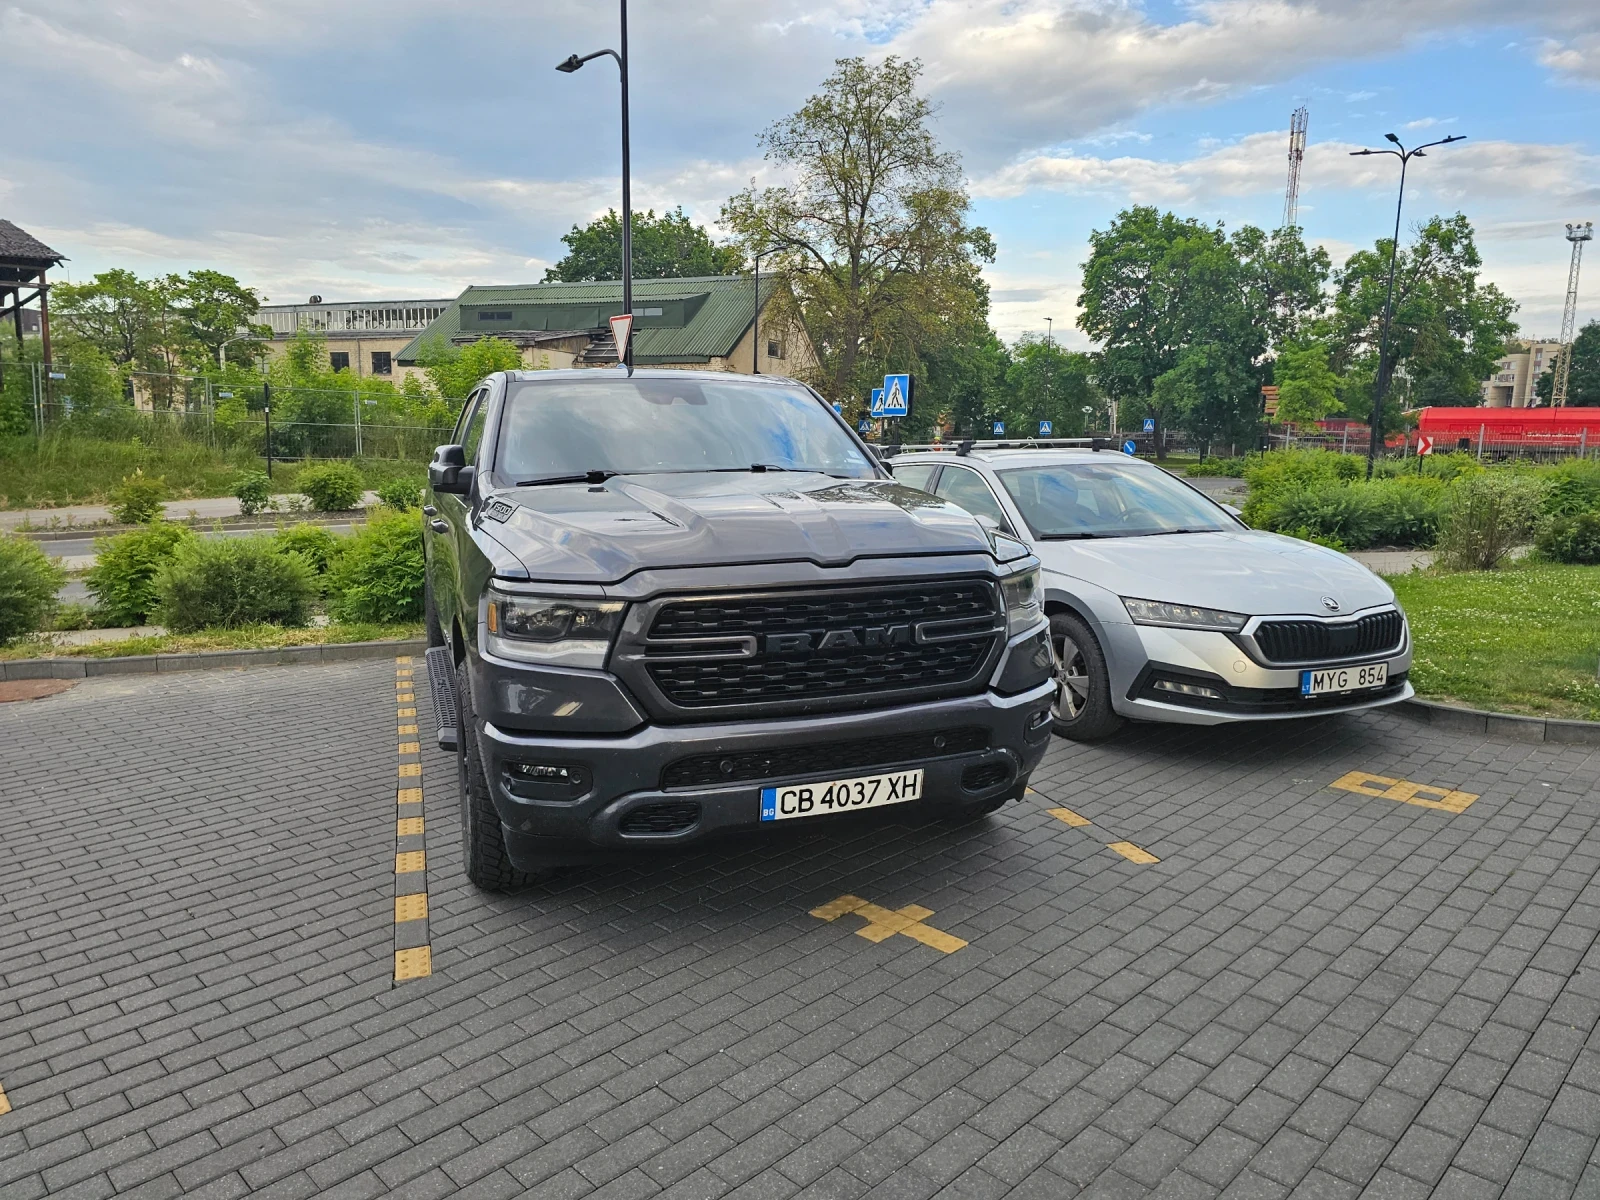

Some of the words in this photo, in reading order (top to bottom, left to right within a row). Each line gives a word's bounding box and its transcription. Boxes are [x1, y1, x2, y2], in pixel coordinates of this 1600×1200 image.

[766, 624, 909, 652] RAM
[1312, 671, 1348, 691] MYG
[1358, 665, 1384, 686] 854
[780, 788, 814, 815] CB
[820, 778, 882, 809] 4037
[886, 773, 918, 801] XH
[762, 808, 775, 817] BG
